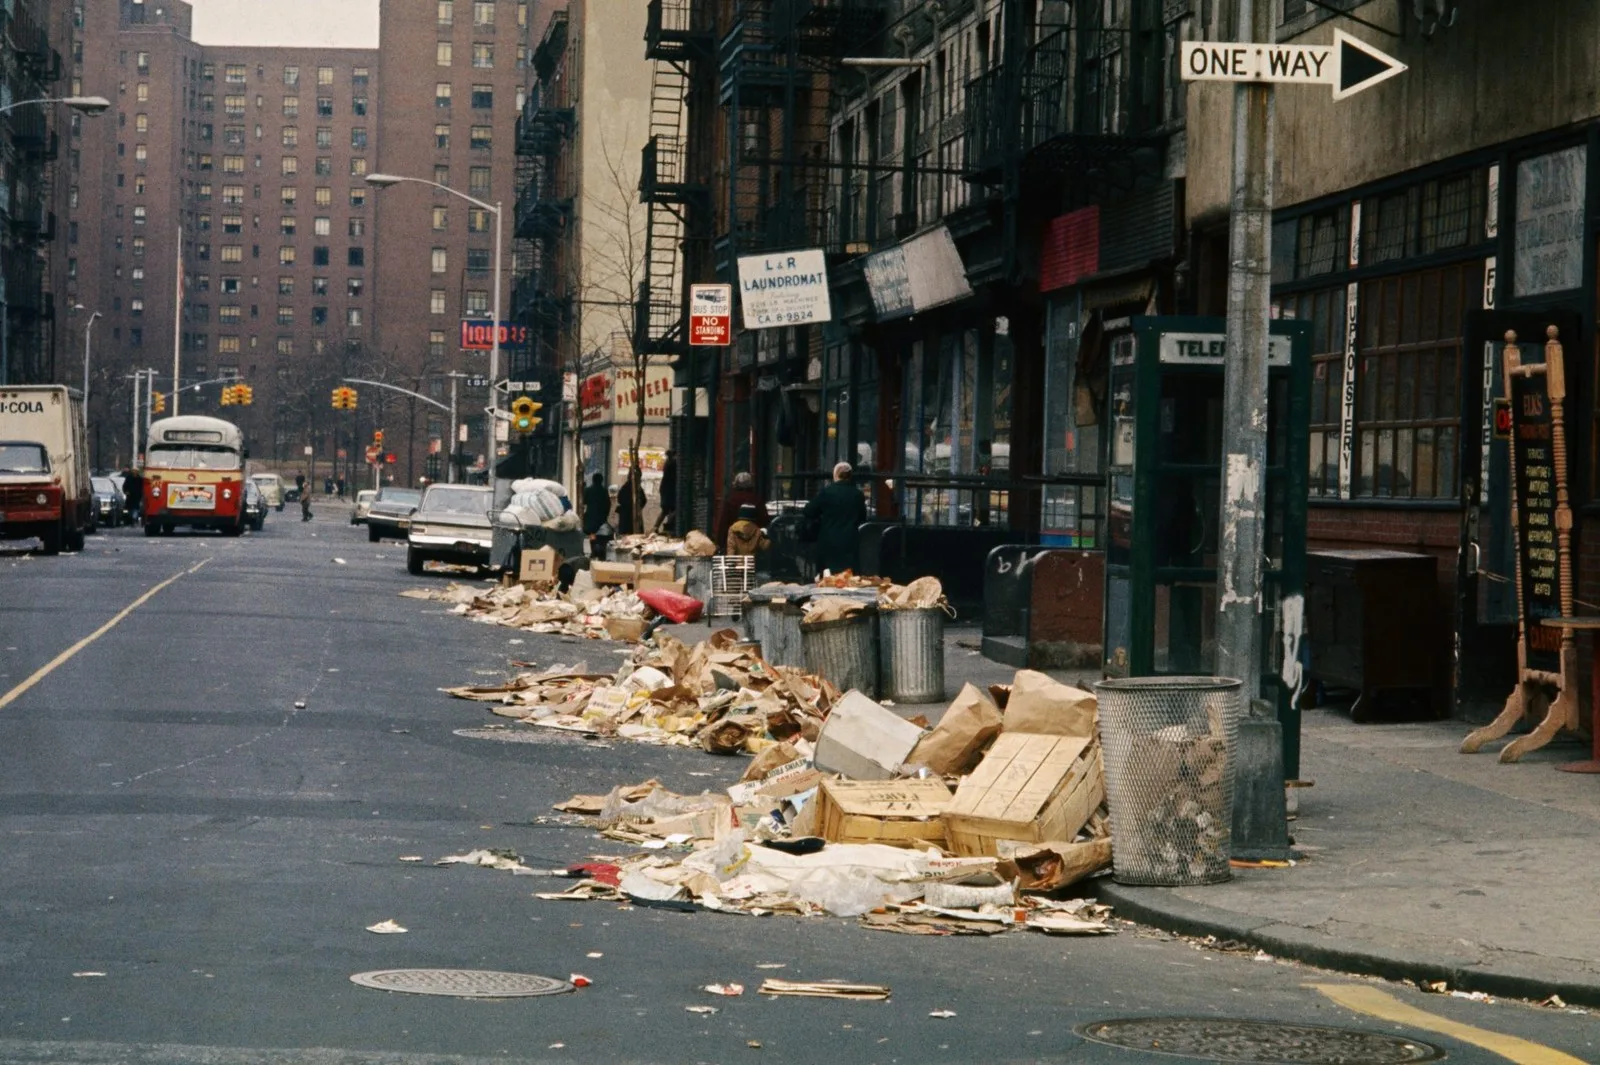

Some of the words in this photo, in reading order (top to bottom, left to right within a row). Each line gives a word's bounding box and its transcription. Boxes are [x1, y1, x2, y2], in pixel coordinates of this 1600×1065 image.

[1190, 48, 1247, 75] ONE
[1269, 50, 1329, 77] WAY
[764, 260, 773, 271] L
[787, 257, 796, 268] R
[744, 272, 823, 291] LAUNDROMAT
[694, 305, 707, 314] BUS
[710, 305, 728, 314] STOP
[702, 316, 719, 326] NO
[695, 326, 725, 335] STANDING
[1342, 304, 1357, 470] UPHOLSTERY
